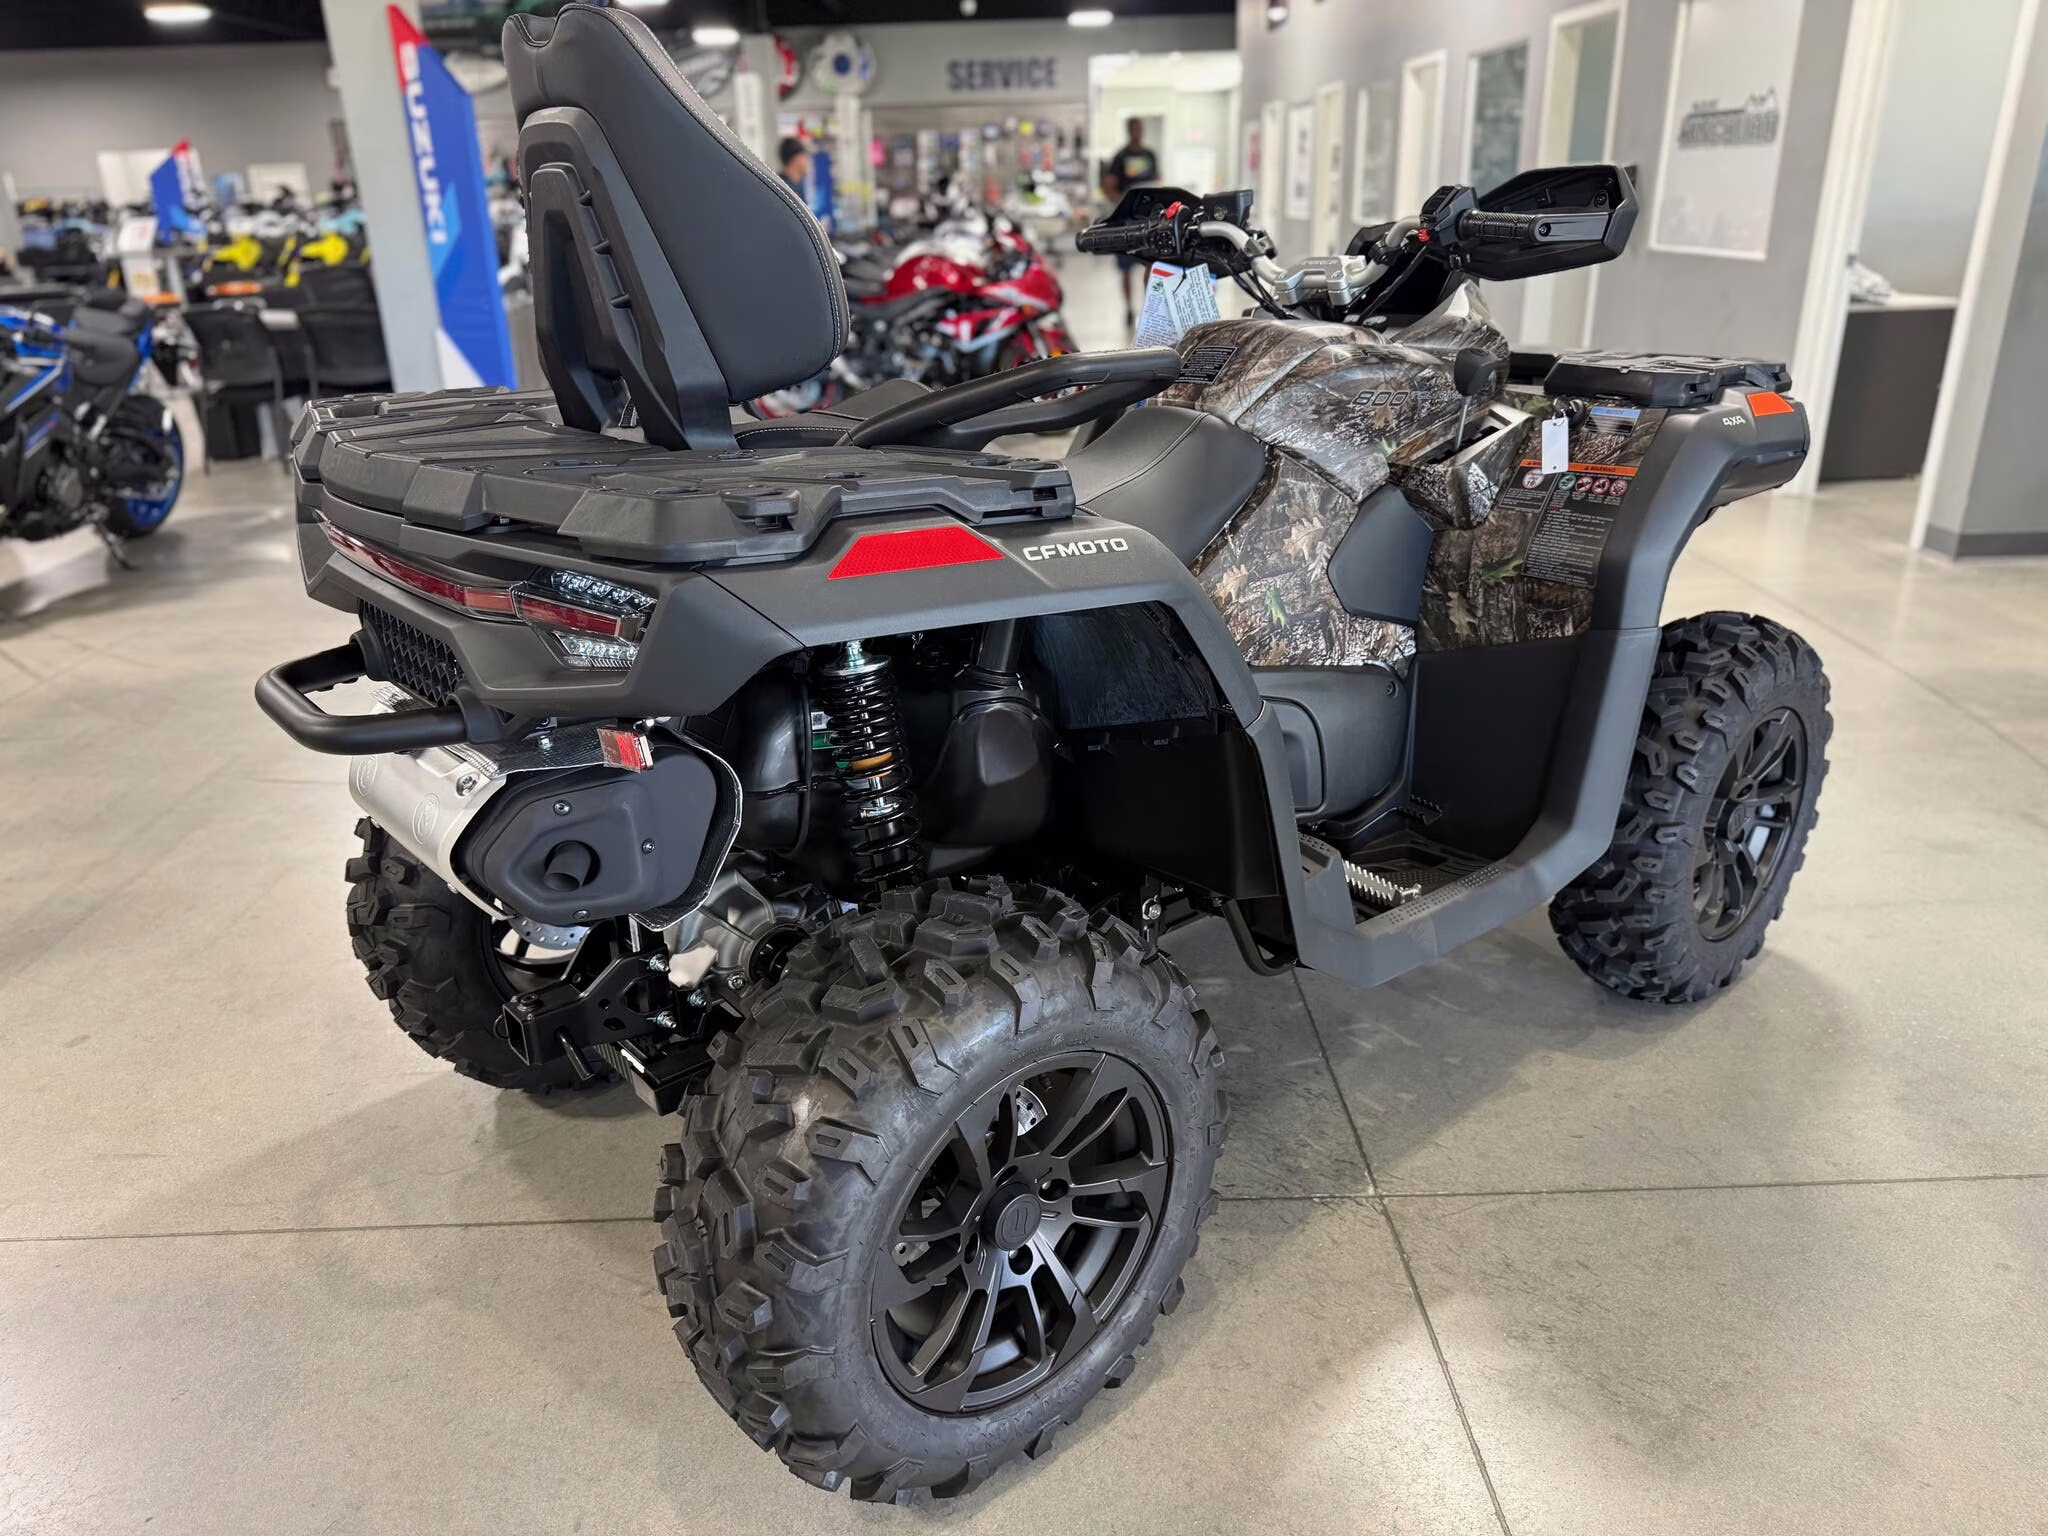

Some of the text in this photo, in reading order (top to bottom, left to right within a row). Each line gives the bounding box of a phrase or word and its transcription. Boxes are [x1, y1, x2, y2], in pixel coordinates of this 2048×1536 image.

[946, 57, 1057, 92] SERVICE
[398, 41, 448, 245] SUZUKI
[1351, 389, 1411, 409] 800
[1022, 537, 1129, 562] CFMOTO
